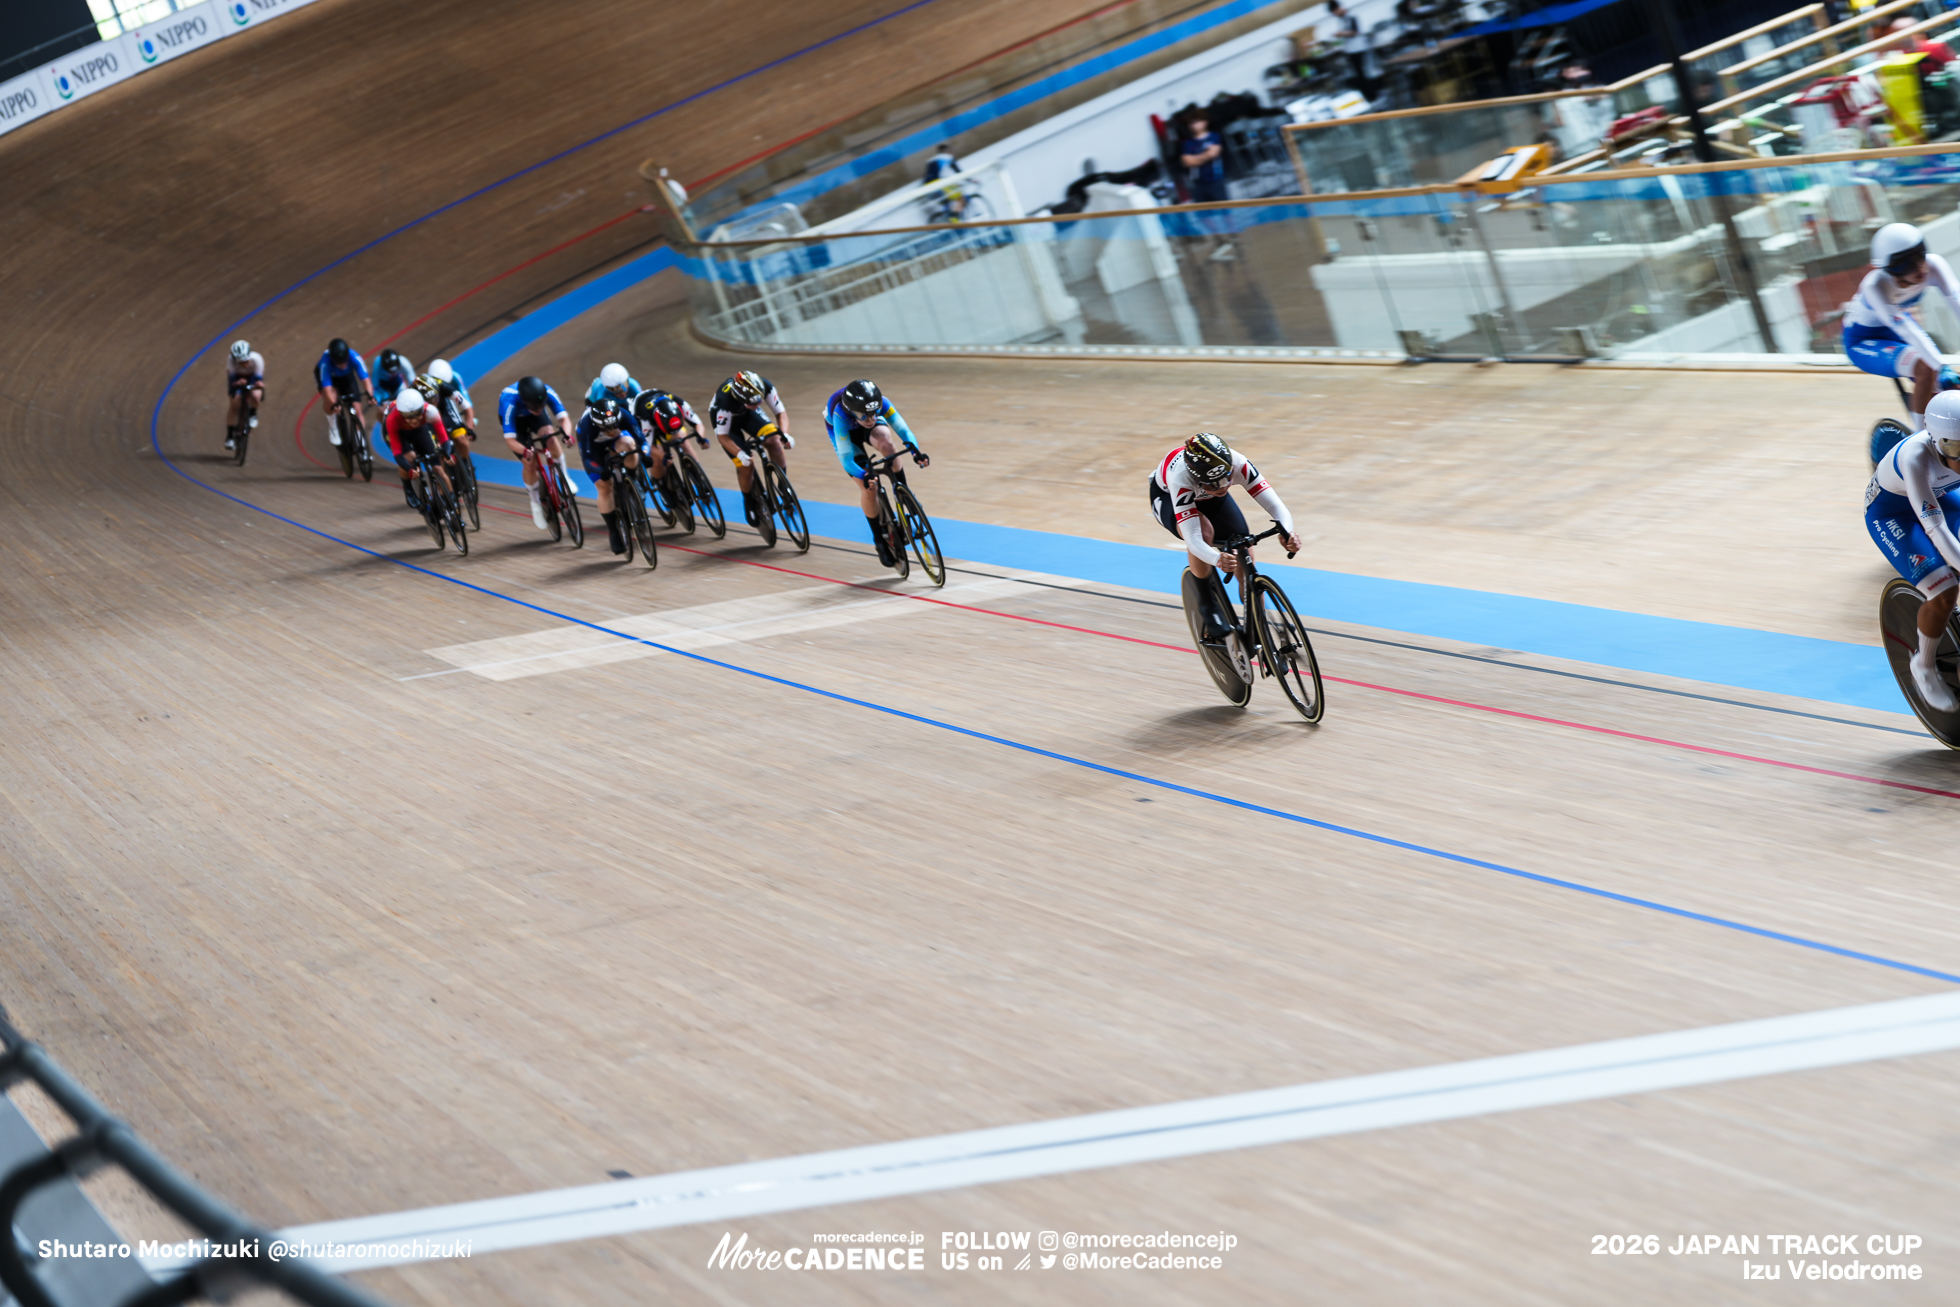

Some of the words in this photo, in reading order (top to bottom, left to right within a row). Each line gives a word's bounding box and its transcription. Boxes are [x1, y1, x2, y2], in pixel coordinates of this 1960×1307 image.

[155, 16, 207, 51] NIPPO
[70, 53, 118, 87] NIPPO
[1873, 520, 1881, 532] Pro
[1880, 531, 1900, 557] Cycling
[1885, 519, 1906, 541] HKSI
